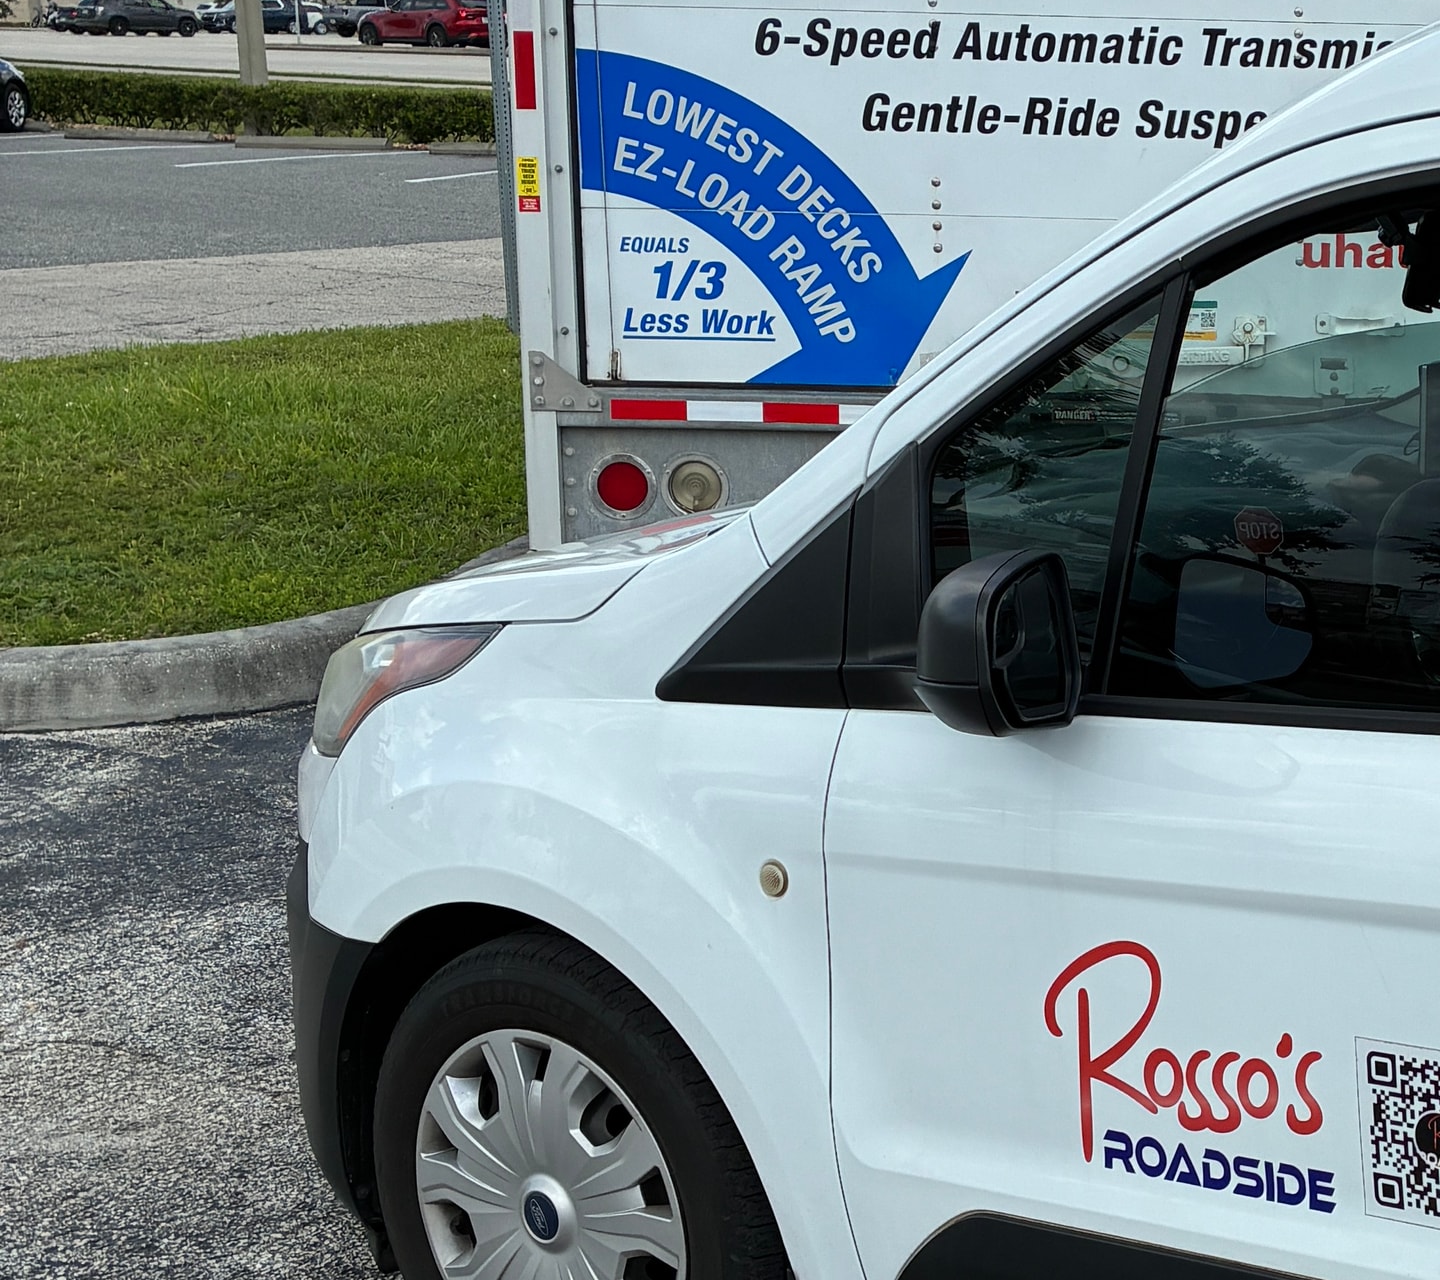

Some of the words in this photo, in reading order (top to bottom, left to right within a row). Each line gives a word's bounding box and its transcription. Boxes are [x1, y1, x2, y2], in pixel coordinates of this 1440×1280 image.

[754, 17, 940, 66] 6-Speed
[953, 21, 1183, 66] Automatic
[1201, 28, 1395, 71] Transmi
[861, 92, 1120, 138] Gentle-Ride
[621, 80, 785, 177] LOWEST
[776, 163, 883, 284] DECKS
[612, 138, 776, 244] EZ-LOAD
[768, 234, 858, 345] RAMP
[619, 236, 690, 254] EQUALS
[652, 260, 728, 302] 1/3
[623, 308, 689, 334] Less
[701, 308, 776, 336] Work
[1043, 940, 1324, 1163] Rosso's
[1102, 1129, 1338, 1214] ROADSIDE
